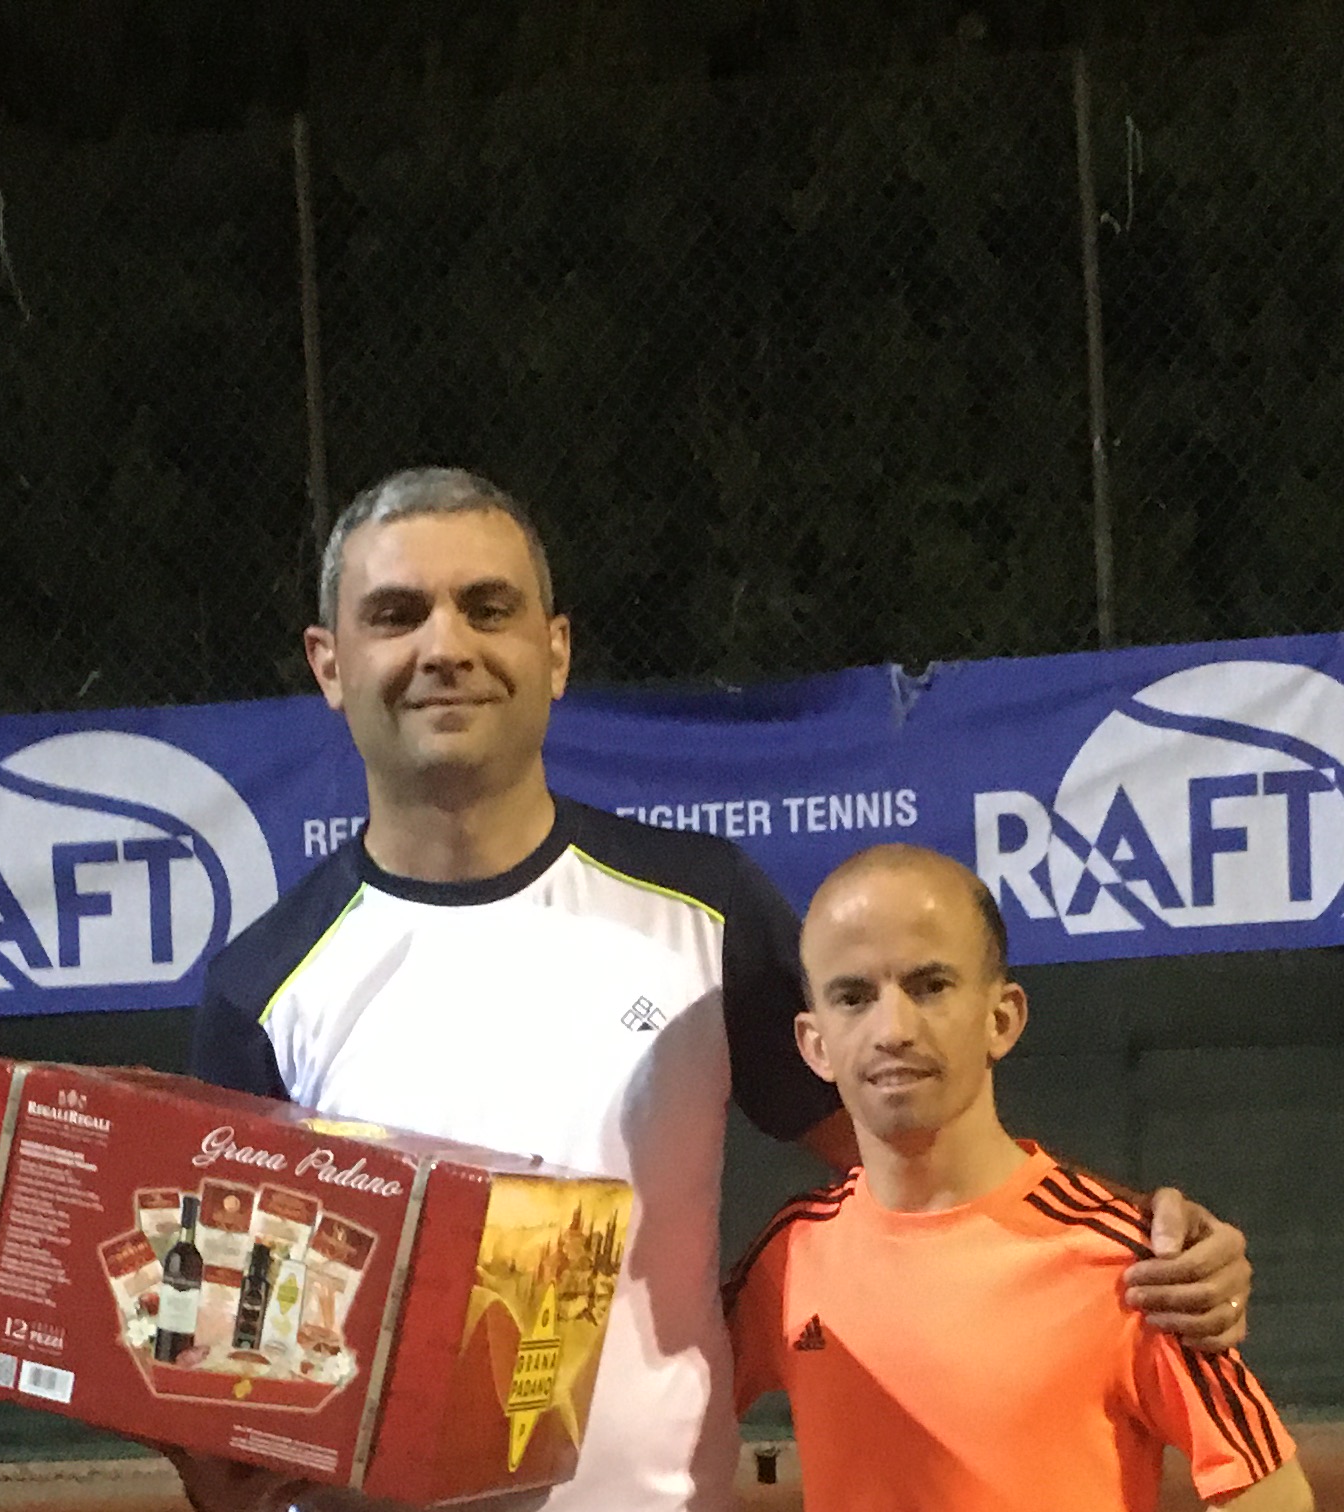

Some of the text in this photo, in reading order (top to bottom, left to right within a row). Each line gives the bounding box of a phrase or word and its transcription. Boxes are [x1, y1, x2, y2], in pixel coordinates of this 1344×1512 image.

[782, 788, 918, 834] TENNIS
[974, 767, 1336, 928] RAFT
[192, 1125, 405, 1198] Grana Padano
[4, 1316, 28, 1341] 12
